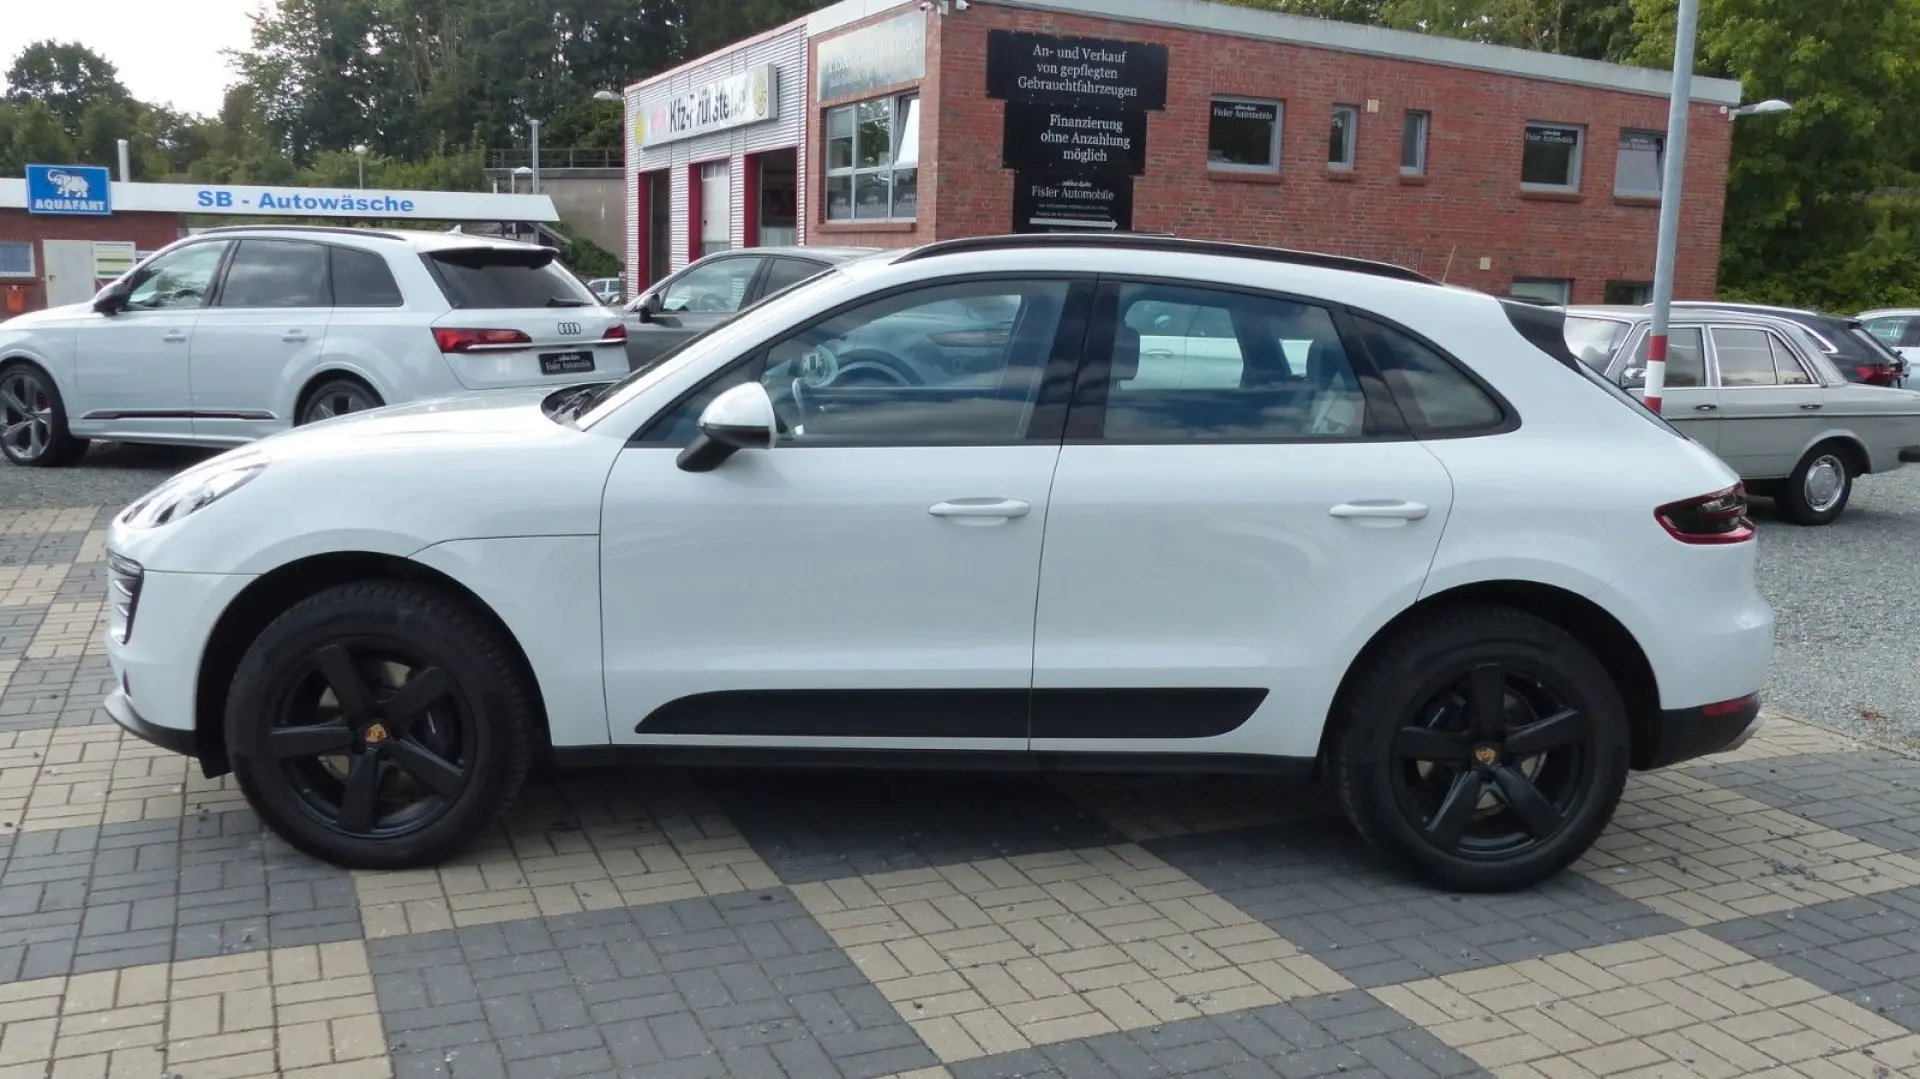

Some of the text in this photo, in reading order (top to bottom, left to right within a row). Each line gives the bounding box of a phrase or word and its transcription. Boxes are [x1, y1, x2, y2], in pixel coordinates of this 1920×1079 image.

[1032, 44, 1128, 63] An- und Verkauf
[1036, 63, 1118, 79] von gepflegten
[1018, 76, 1138, 98] Gebrauchtfahrzeugen
[1050, 114, 1123, 133] Finanzierung
[1040, 131, 1131, 150] ohne Anzahlung
[1063, 148, 1108, 163] möglich
[198, 190, 233, 207] SB
[258, 192, 414, 212] Autowäsche
[1031, 185, 1114, 200] Fisler Automobile
[35, 198, 105, 211] AQUAFANT
